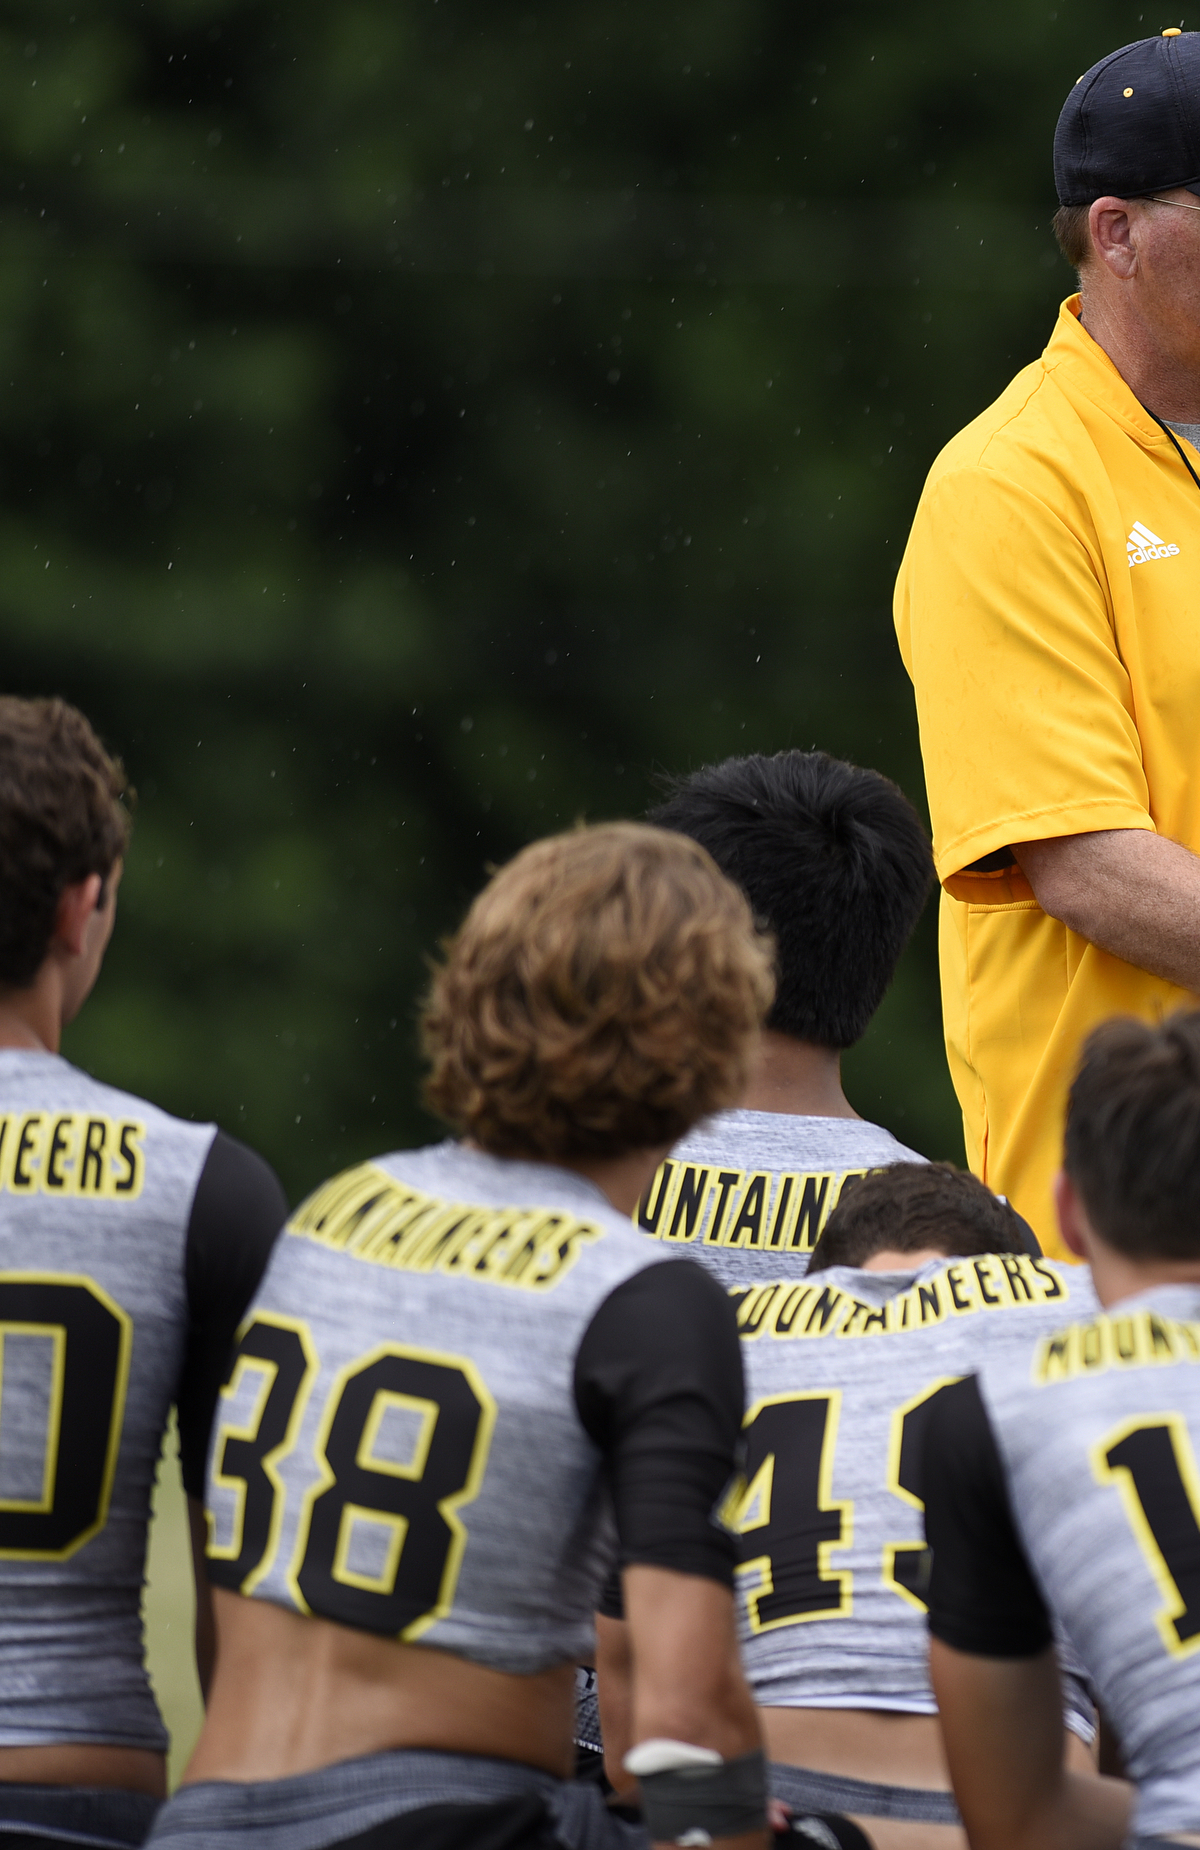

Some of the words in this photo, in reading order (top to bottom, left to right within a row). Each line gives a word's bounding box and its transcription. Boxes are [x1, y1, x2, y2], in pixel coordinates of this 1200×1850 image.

[0, 1112, 146, 1201] EERS
[730, 1253, 1069, 1341] OUNTAINEERS
[204, 1307, 498, 1642] 38
